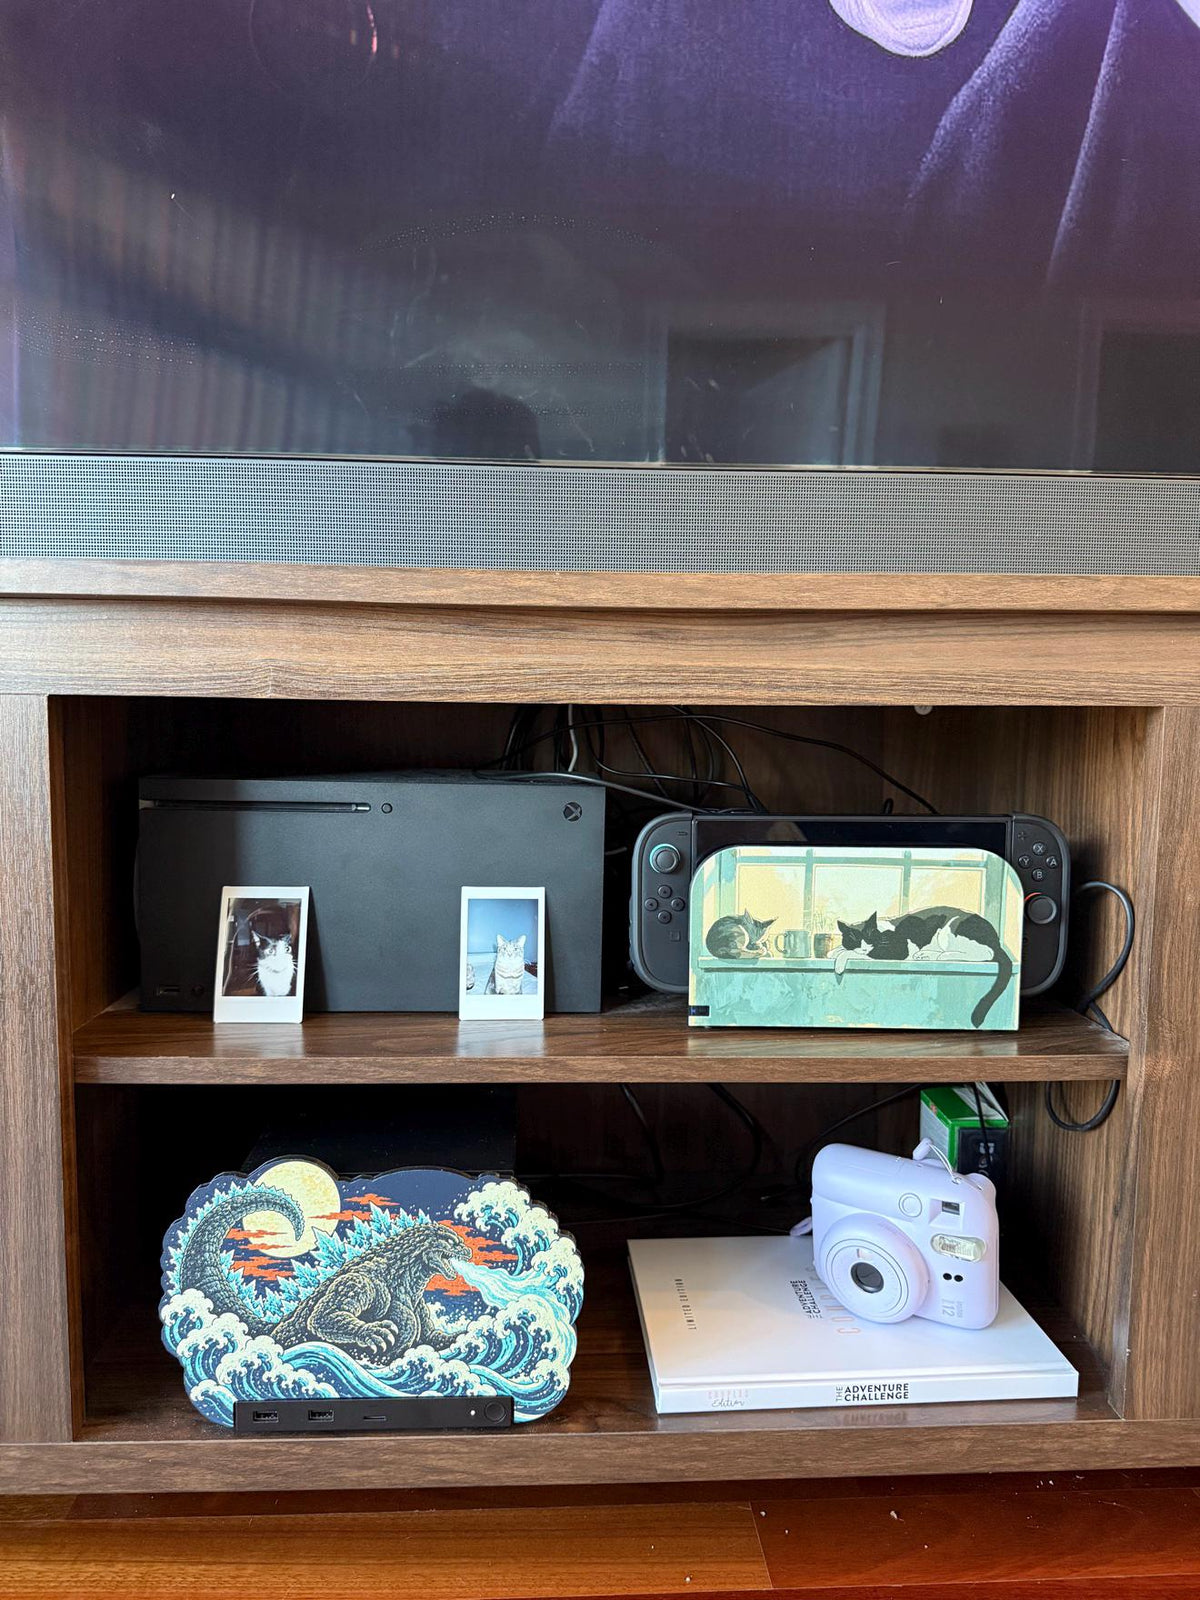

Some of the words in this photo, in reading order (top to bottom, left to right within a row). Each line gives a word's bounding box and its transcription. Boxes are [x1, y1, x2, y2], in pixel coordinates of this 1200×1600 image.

[1037, 844, 1044, 853] X
[1023, 858, 1030, 866] Y
[1050, 858, 1057, 866] A
[1036, 871, 1043, 879] B
[789, 1280, 812, 1315] ADVENTURE
[799, 1280, 821, 1314] CHALLENGE
[681, 1304, 697, 1330] LIMITED
[844, 1382, 909, 1394] ADVENTURE
[835, 1386, 843, 1402] THE
[844, 1391, 909, 1402] CHALLENGE
